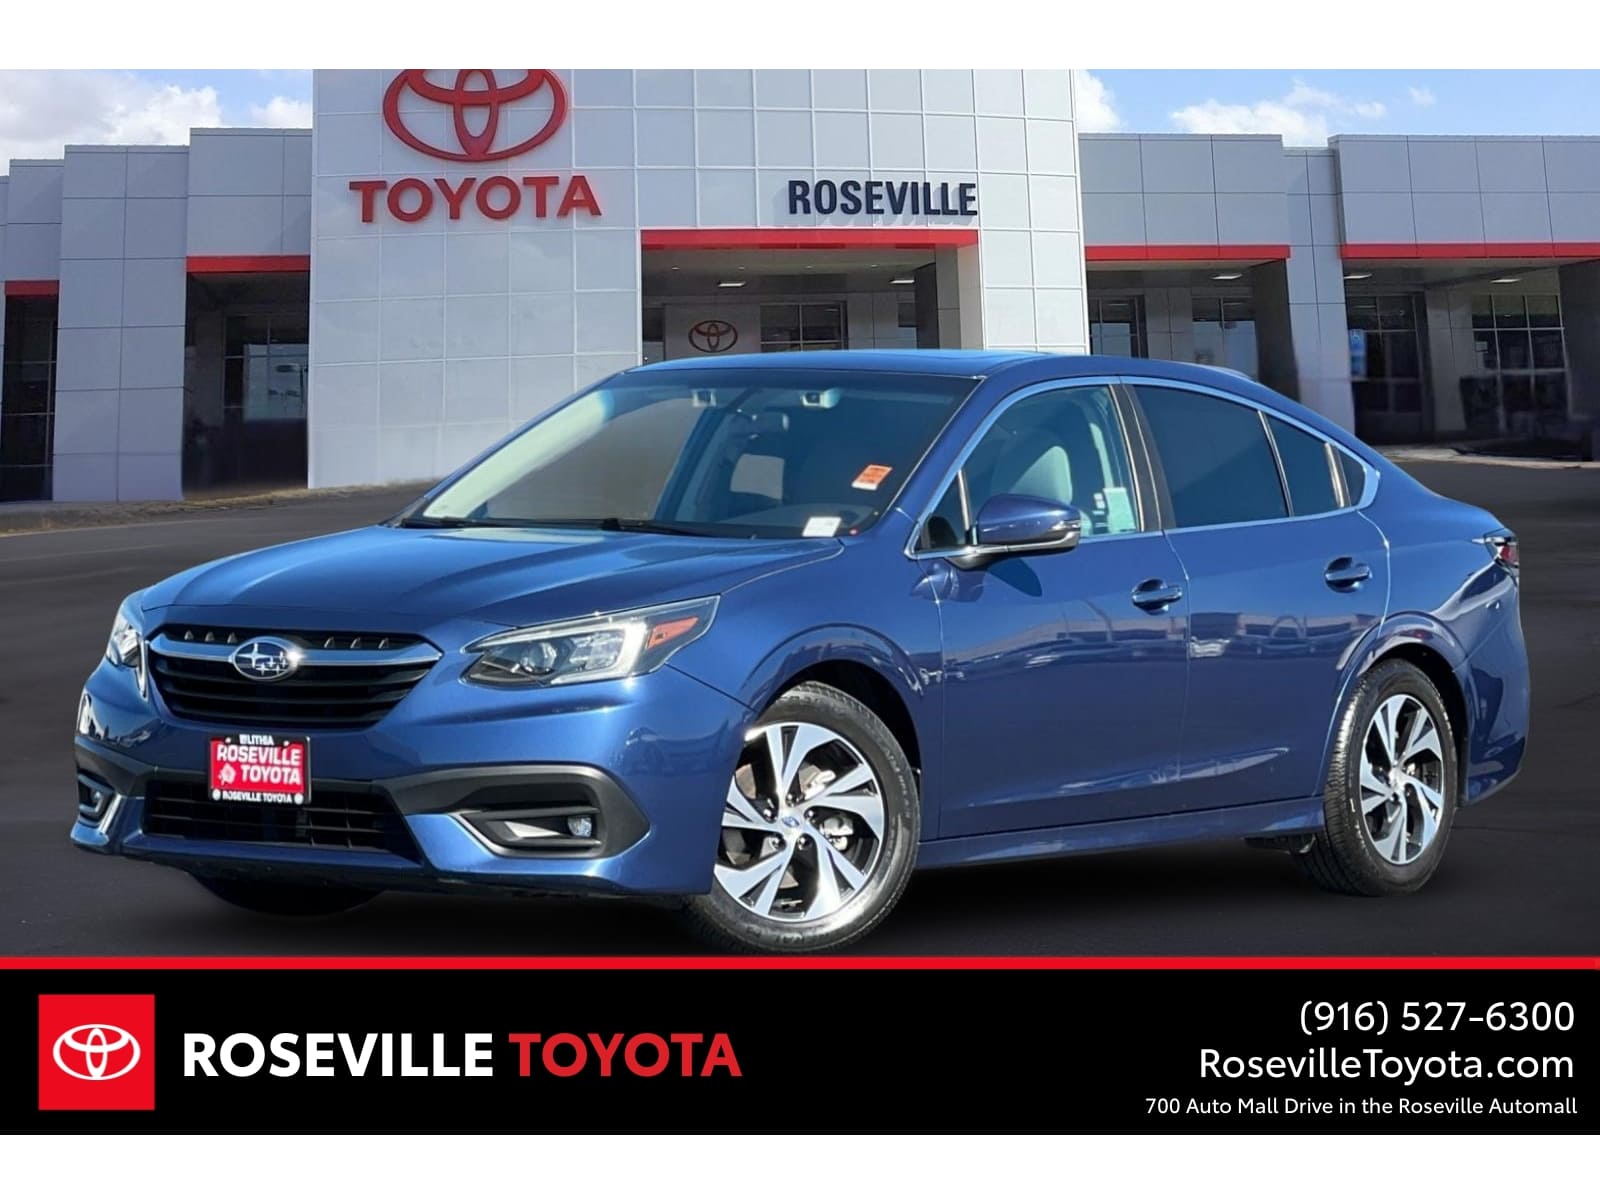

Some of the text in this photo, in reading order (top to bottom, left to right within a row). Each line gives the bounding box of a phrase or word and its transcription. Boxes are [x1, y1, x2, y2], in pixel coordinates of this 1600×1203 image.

[350, 175, 602, 223] TOYOTA
[788, 180, 978, 217] ROSEVILLE
[216, 744, 302, 767] ROSEVILLE
[241, 764, 301, 786] TOYOTA
[222, 790, 293, 804] ROSEVILLE TOYOTA
